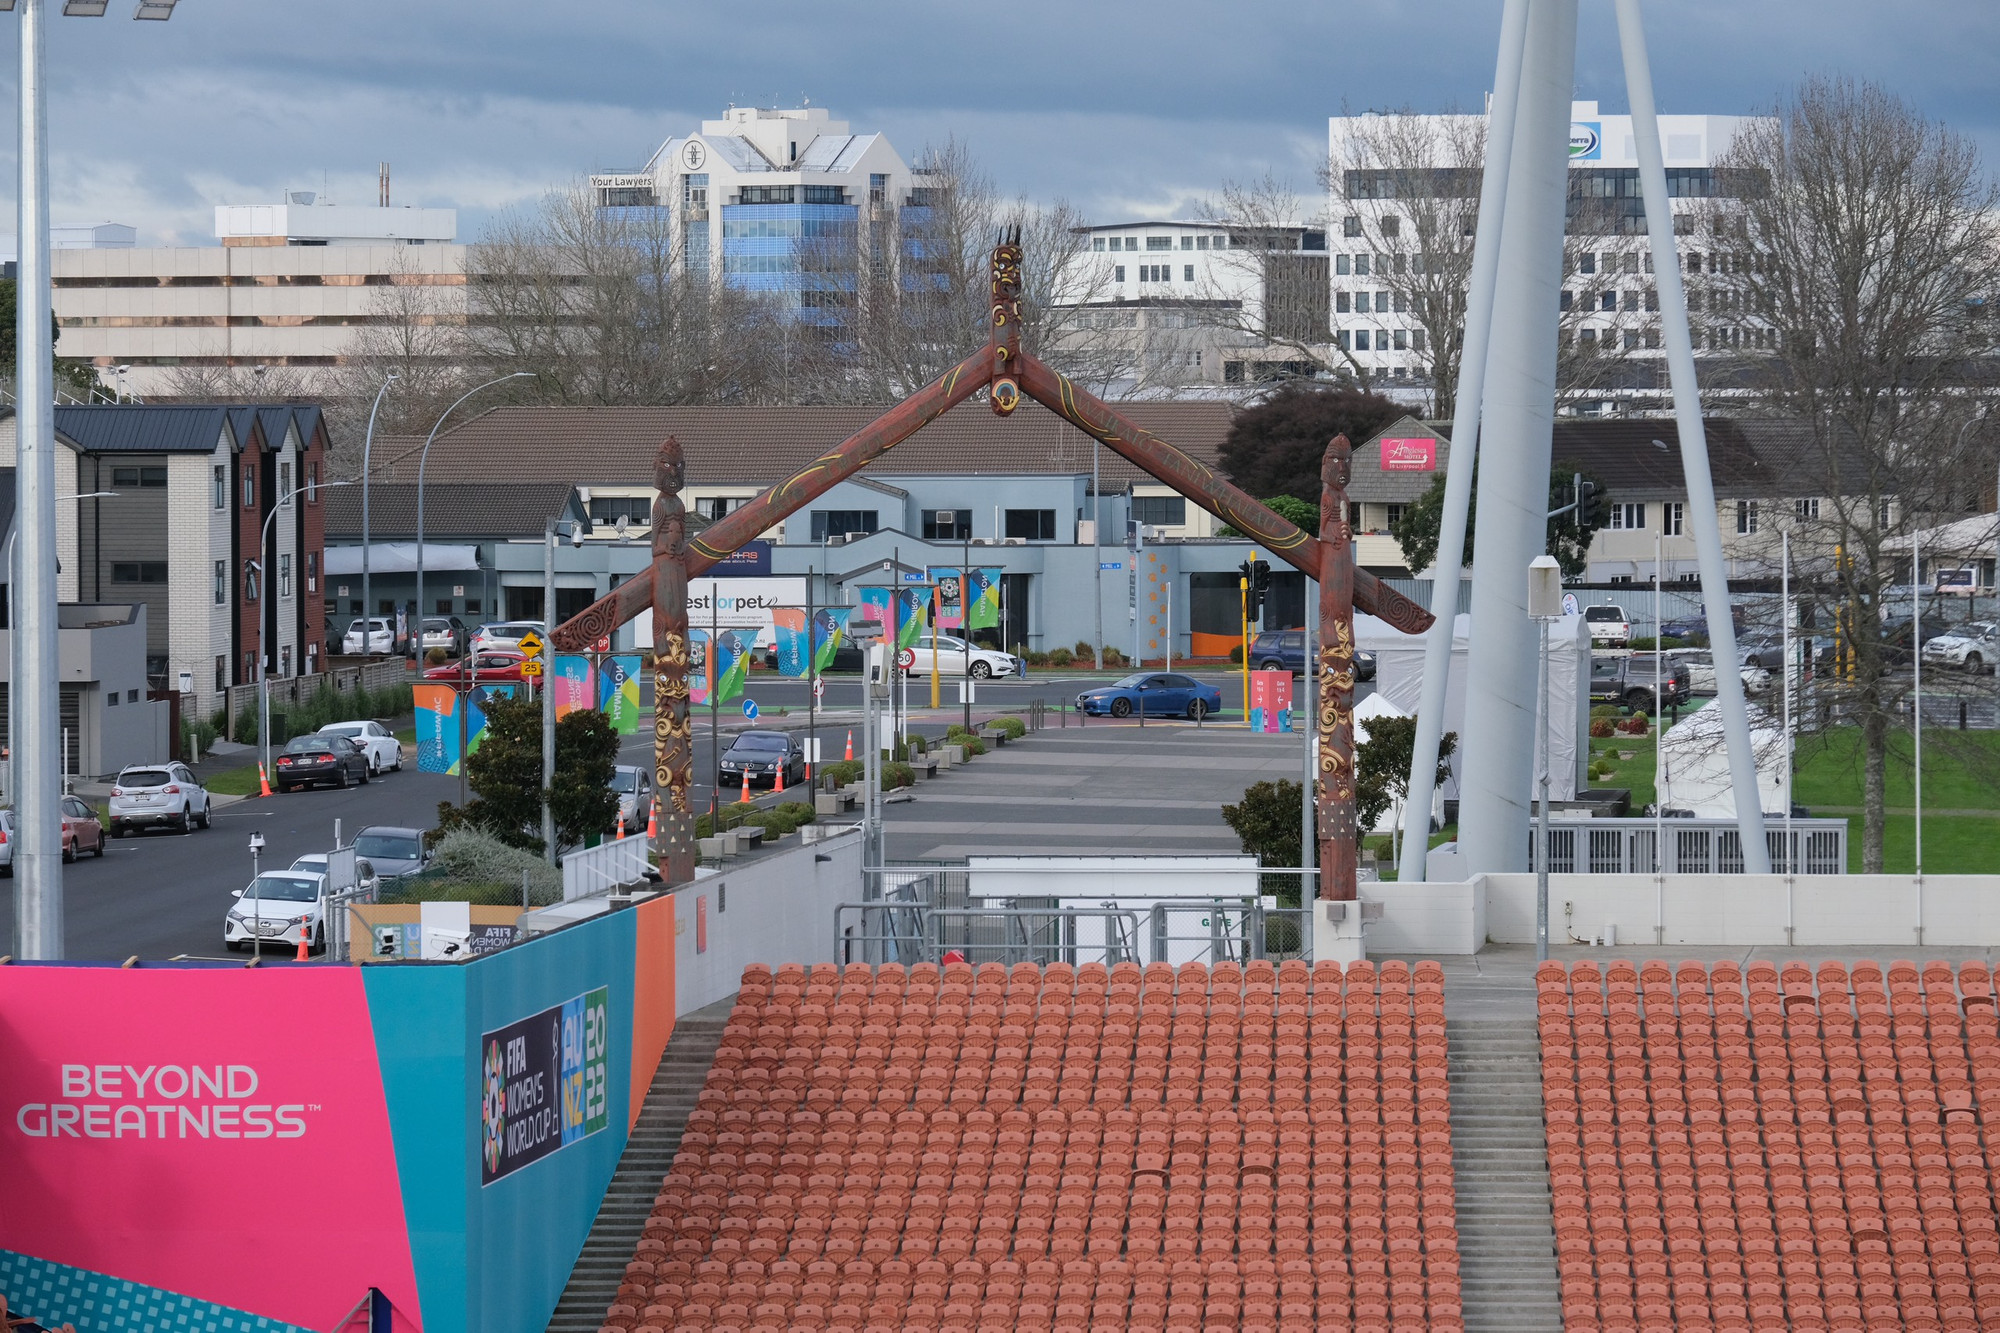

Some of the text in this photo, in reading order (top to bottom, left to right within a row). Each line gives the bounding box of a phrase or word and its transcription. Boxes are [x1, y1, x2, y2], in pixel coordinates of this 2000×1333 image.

[592, 178, 652, 187] Your Lawyers
[524, 664, 537, 672] 25
[898, 653, 910, 662] 50
[1201, 918, 1232, 927] GE
[563, 1012, 584, 1072] AU
[586, 1004, 606, 1062] 20
[507, 1036, 527, 1078] FIFA
[62, 1064, 258, 1098] BEYOND
[507, 1072, 544, 1118] WOMEN'S
[564, 1071, 584, 1130] NZ
[586, 1062, 606, 1120] 23
[16, 1104, 306, 1138] GREATNESS
[507, 1107, 550, 1158] WORLD CUP
